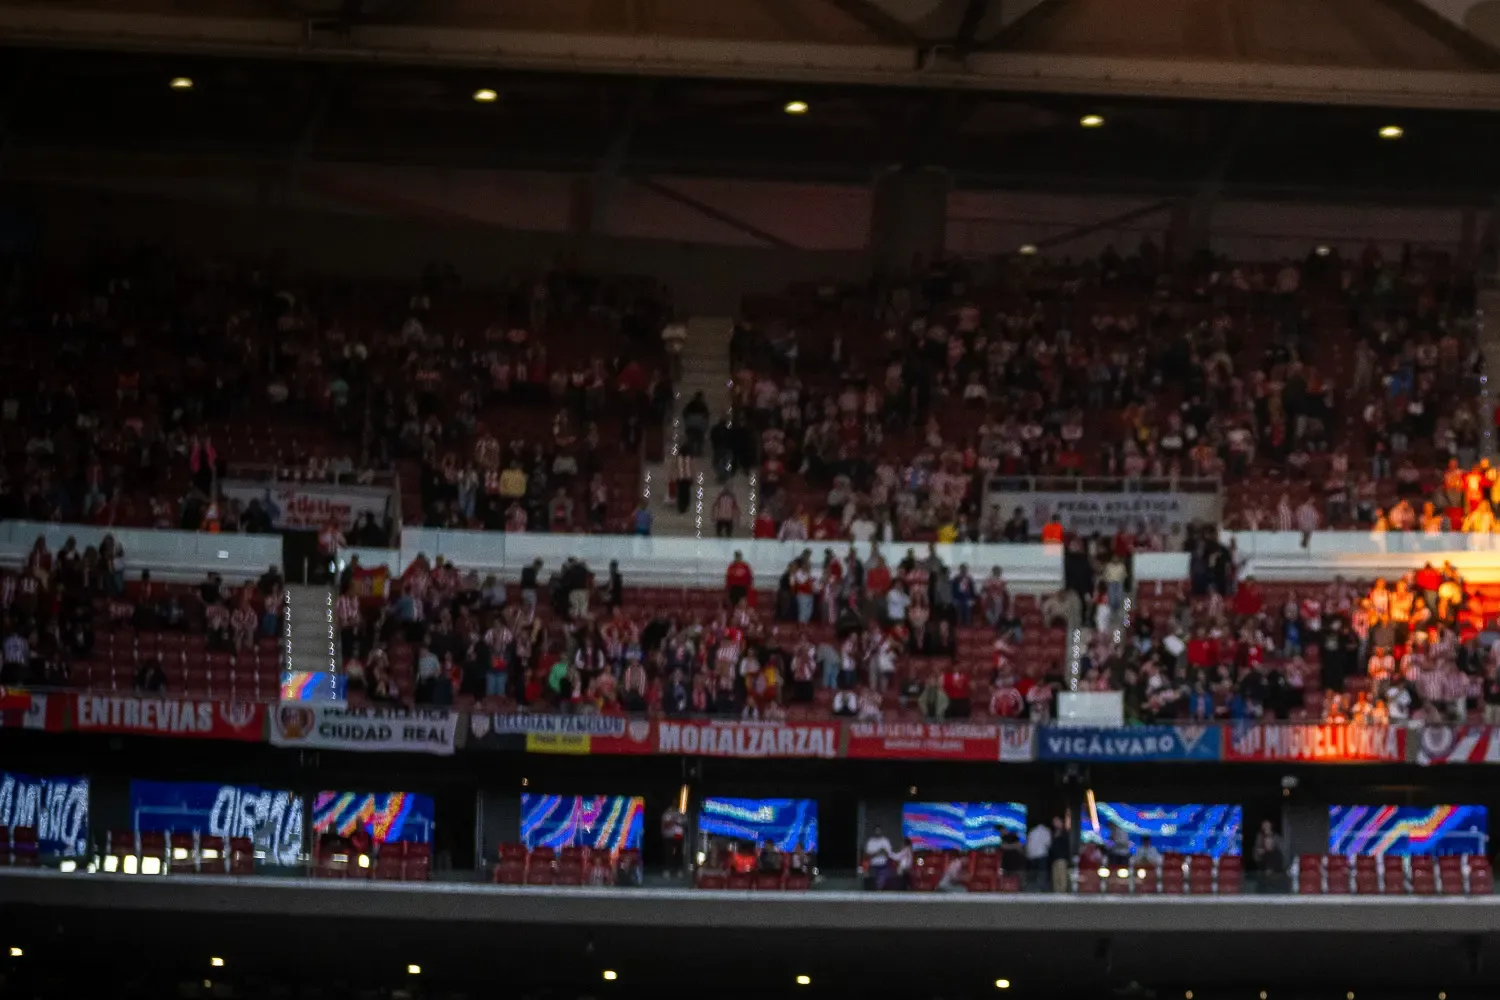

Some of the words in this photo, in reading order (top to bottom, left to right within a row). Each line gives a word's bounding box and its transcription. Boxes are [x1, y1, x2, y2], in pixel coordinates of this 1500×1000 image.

[77, 696, 214, 732] ENTREVIAS
[318, 722, 393, 742] CIUDAD
[402, 724, 449, 745] REAL
[658, 722, 837, 759] MORALZARZAL
[1048, 734, 1175, 755] VICÁLVARO
